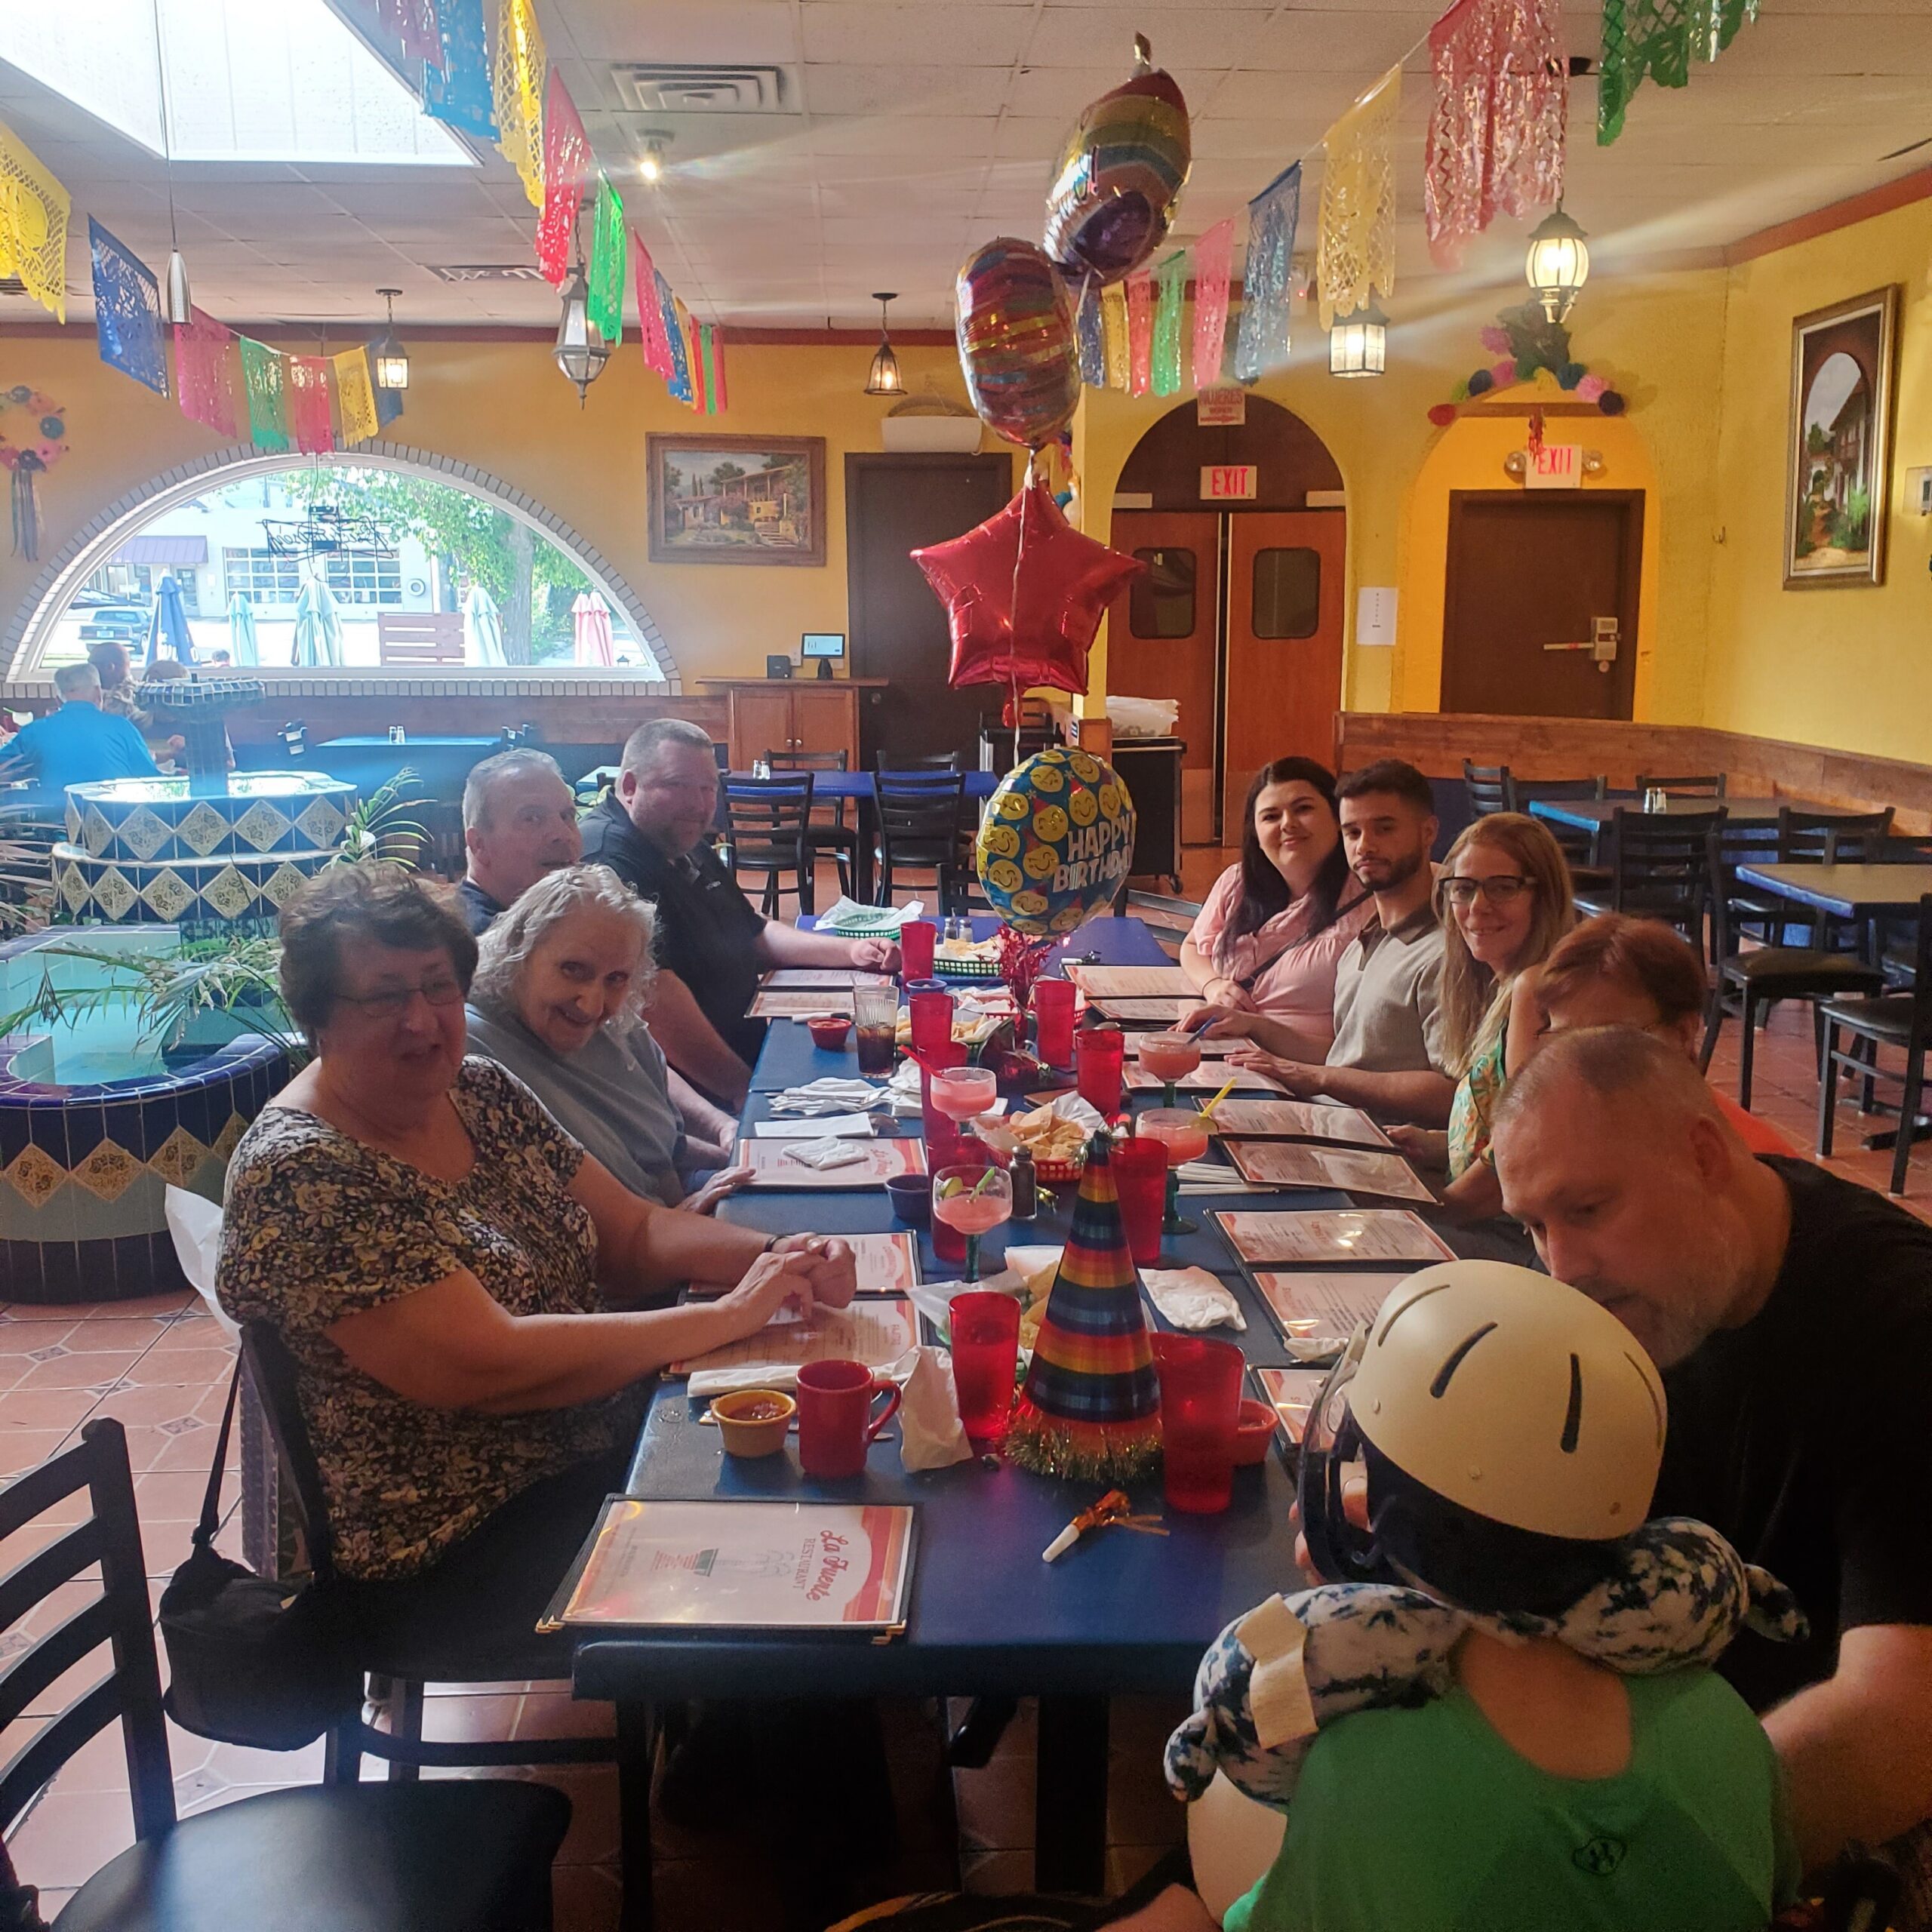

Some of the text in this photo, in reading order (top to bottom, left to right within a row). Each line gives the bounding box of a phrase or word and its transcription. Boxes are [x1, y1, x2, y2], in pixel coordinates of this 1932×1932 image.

[1211, 468, 1247, 496] EXIT
[1537, 447, 1571, 475] EXIT
[1068, 813, 1130, 861] HAPPY
[1053, 845, 1131, 893] BIRTHDA
[792, 1538, 816, 1589] RESTAURANT
[806, 1530, 848, 1601] La Fuente
